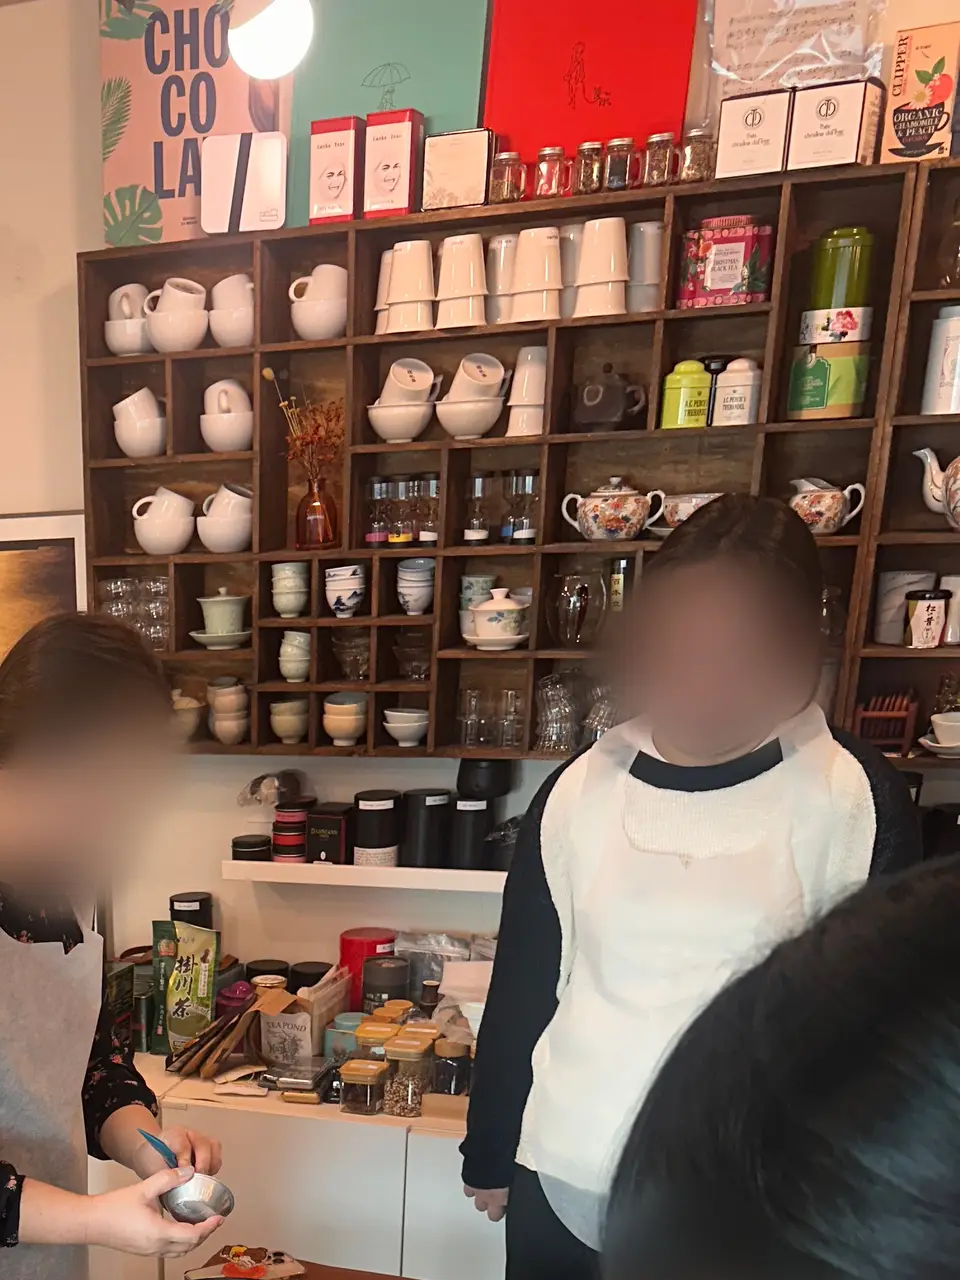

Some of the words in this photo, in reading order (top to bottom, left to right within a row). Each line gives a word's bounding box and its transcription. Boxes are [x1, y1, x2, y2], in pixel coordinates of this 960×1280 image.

[144, 4, 230, 75] CHO
[891, 36, 910, 97] CLIPPER
[160, 71, 217, 137] CO
[893, 107, 943, 122] ORGANIC
[906, 125, 935, 137] PEACH
[153, 137, 202, 200] LA
[172, 953, 199, 1019] 掛川茶
[266, 1020, 282, 1030] TEA
[282, 1022, 307, 1032] POND
